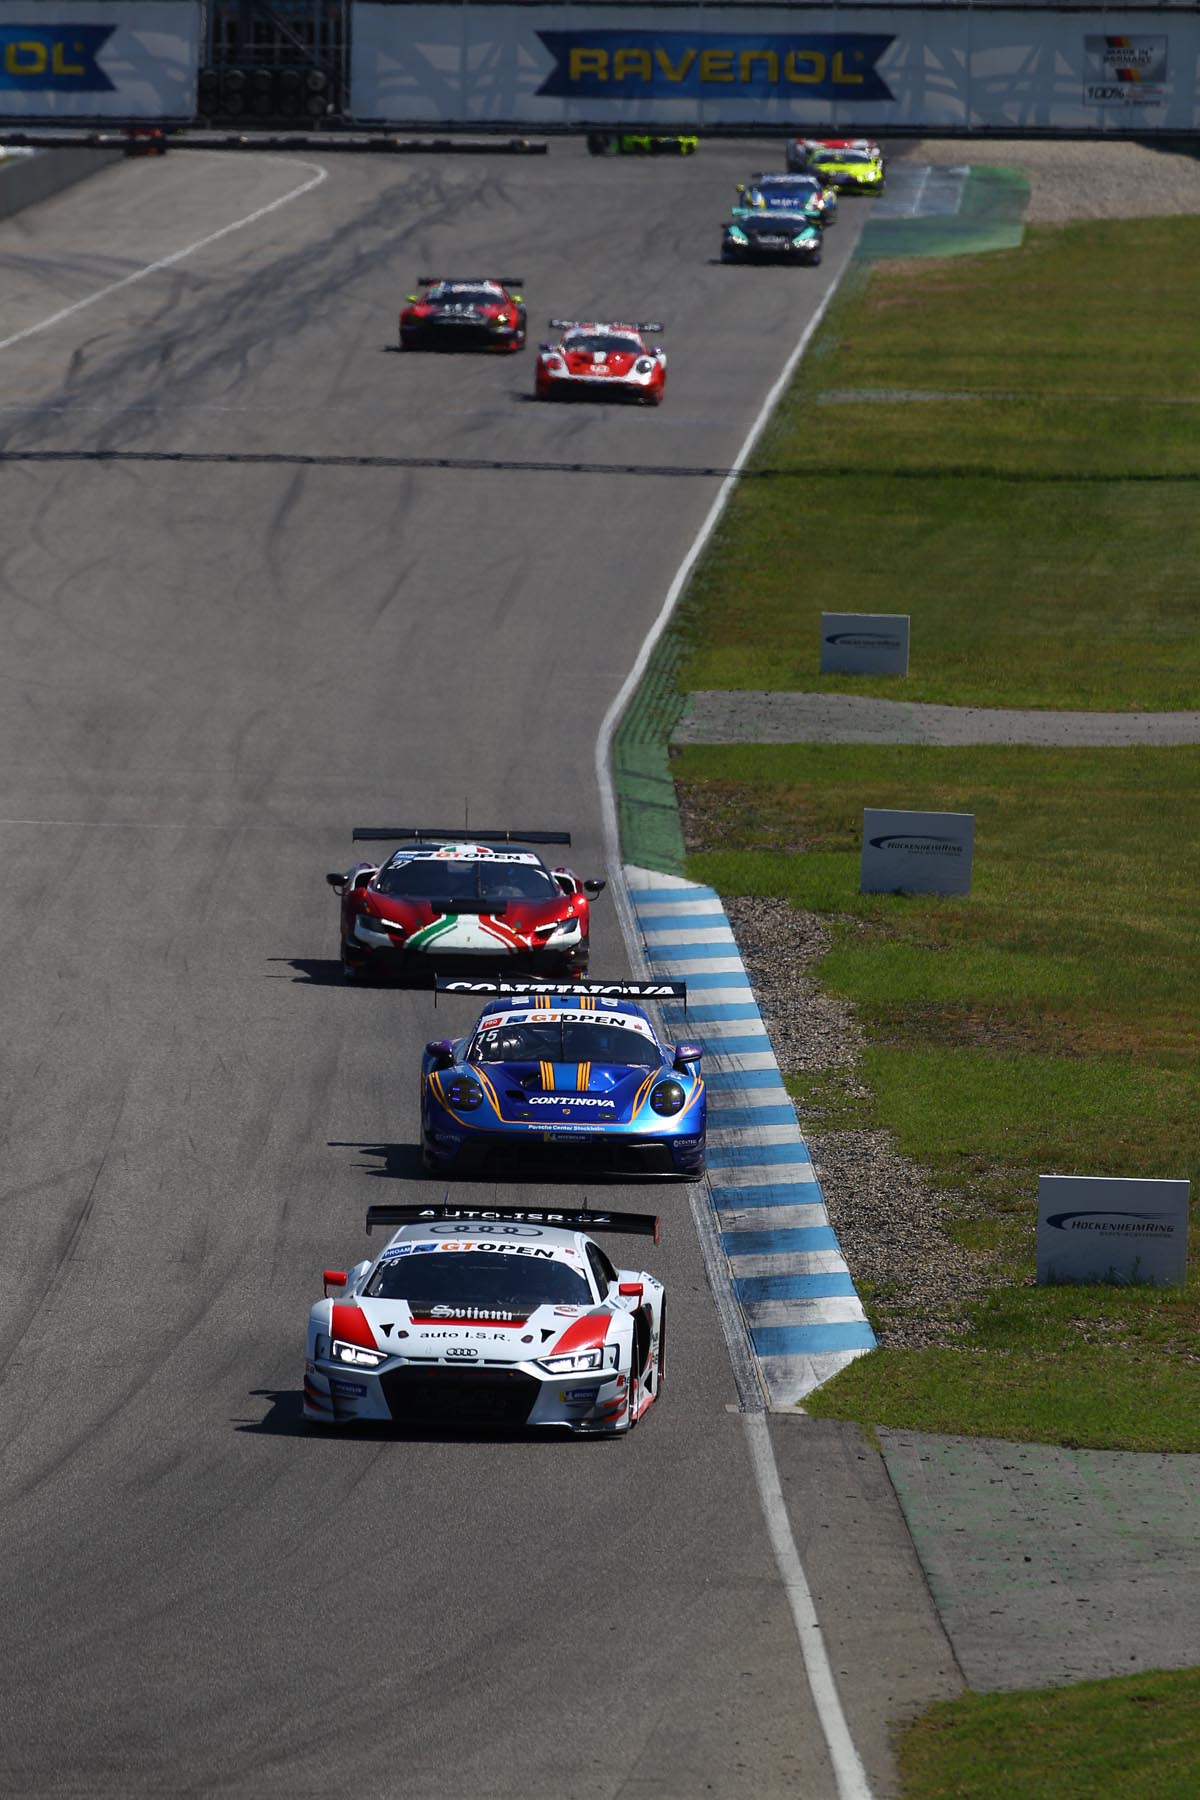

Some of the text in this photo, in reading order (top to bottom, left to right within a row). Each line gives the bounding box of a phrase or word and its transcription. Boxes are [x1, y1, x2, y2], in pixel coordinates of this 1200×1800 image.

[568, 48, 864, 84] RAVENOL
[446, 981, 676, 996] CONTINOVA
[484, 1019, 498, 1028] PRO
[477, 1029, 500, 1045] 15
[528, 1096, 616, 1108] CONTINOVA
[384, 1246, 411, 1258] PROAM
[420, 1331, 511, 1342] auto I.S.R.
